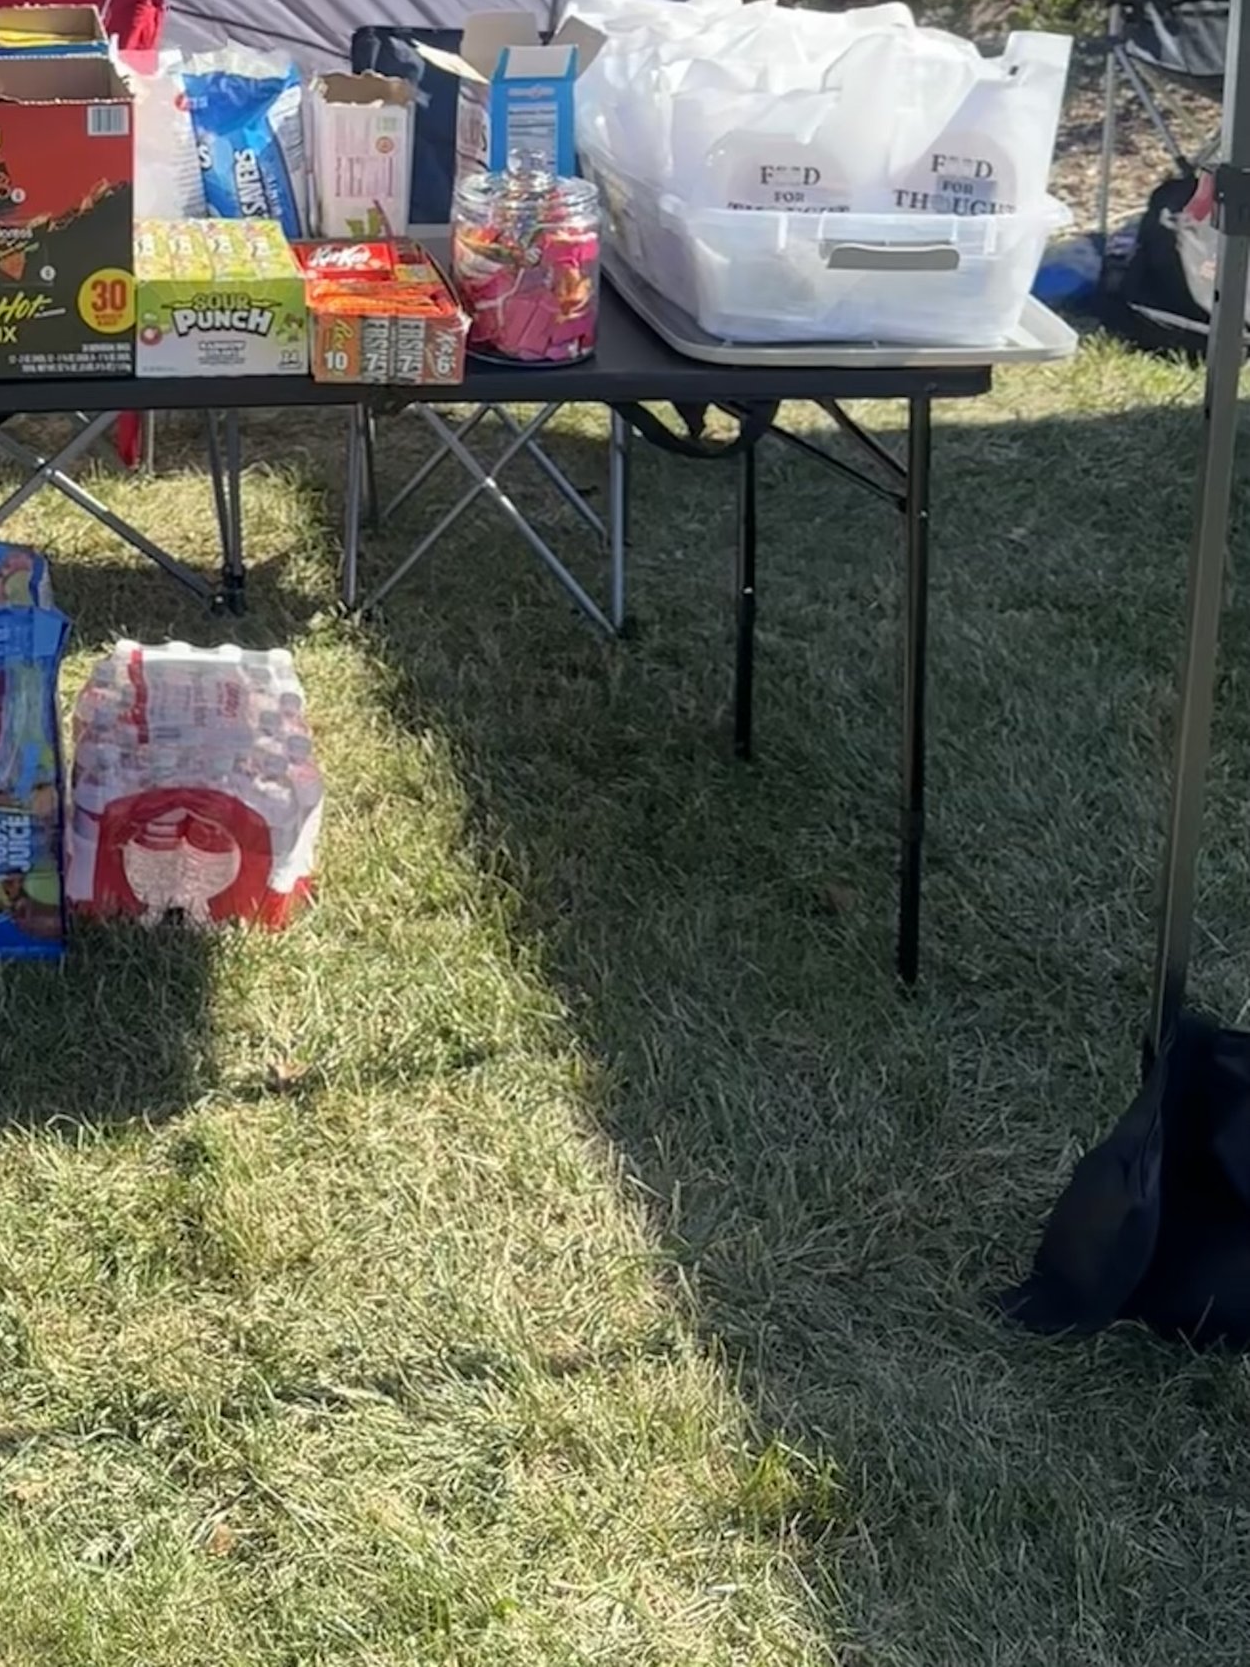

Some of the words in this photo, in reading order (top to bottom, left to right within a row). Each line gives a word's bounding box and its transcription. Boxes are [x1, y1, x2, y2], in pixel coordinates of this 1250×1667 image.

[774, 191, 805, 203] FOR
[941, 179, 974, 195] FOR
[90, 278, 128, 313] 30
[193, 292, 251, 311] SOUR
[172, 308, 274, 337] PUNCH
[324, 351, 349, 371] 10
[7, 815, 32, 873] JUICE
